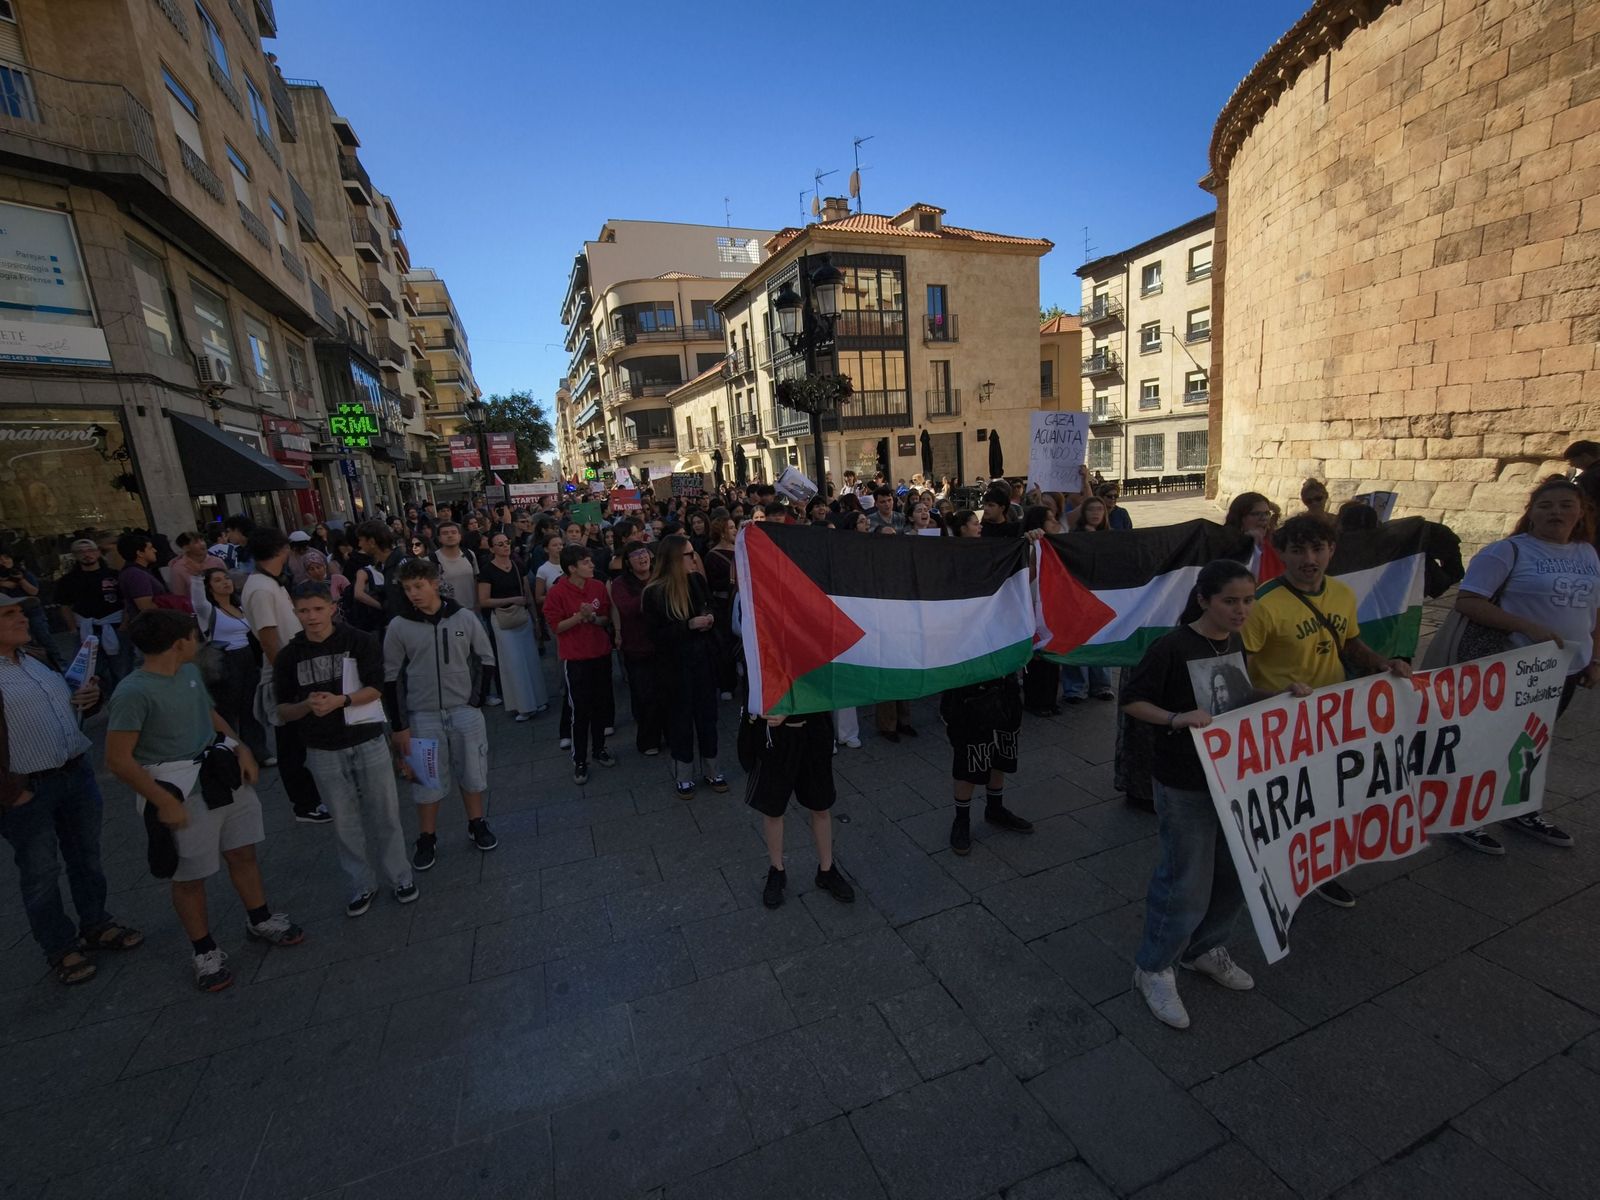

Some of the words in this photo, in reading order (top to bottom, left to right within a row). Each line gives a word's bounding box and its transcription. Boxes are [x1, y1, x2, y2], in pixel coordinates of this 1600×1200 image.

[19, 273, 52, 284] Forense
[1033, 428, 1083, 445] AGUANTA
[1550, 576, 1593, 608] 92
[1526, 675, 1538, 688] de
[1203, 680, 1395, 793] PARARLO
[1411, 661, 1505, 724] TODO
[1230, 767, 1316, 873] PARA
[1336, 724, 1461, 808] PARAR
